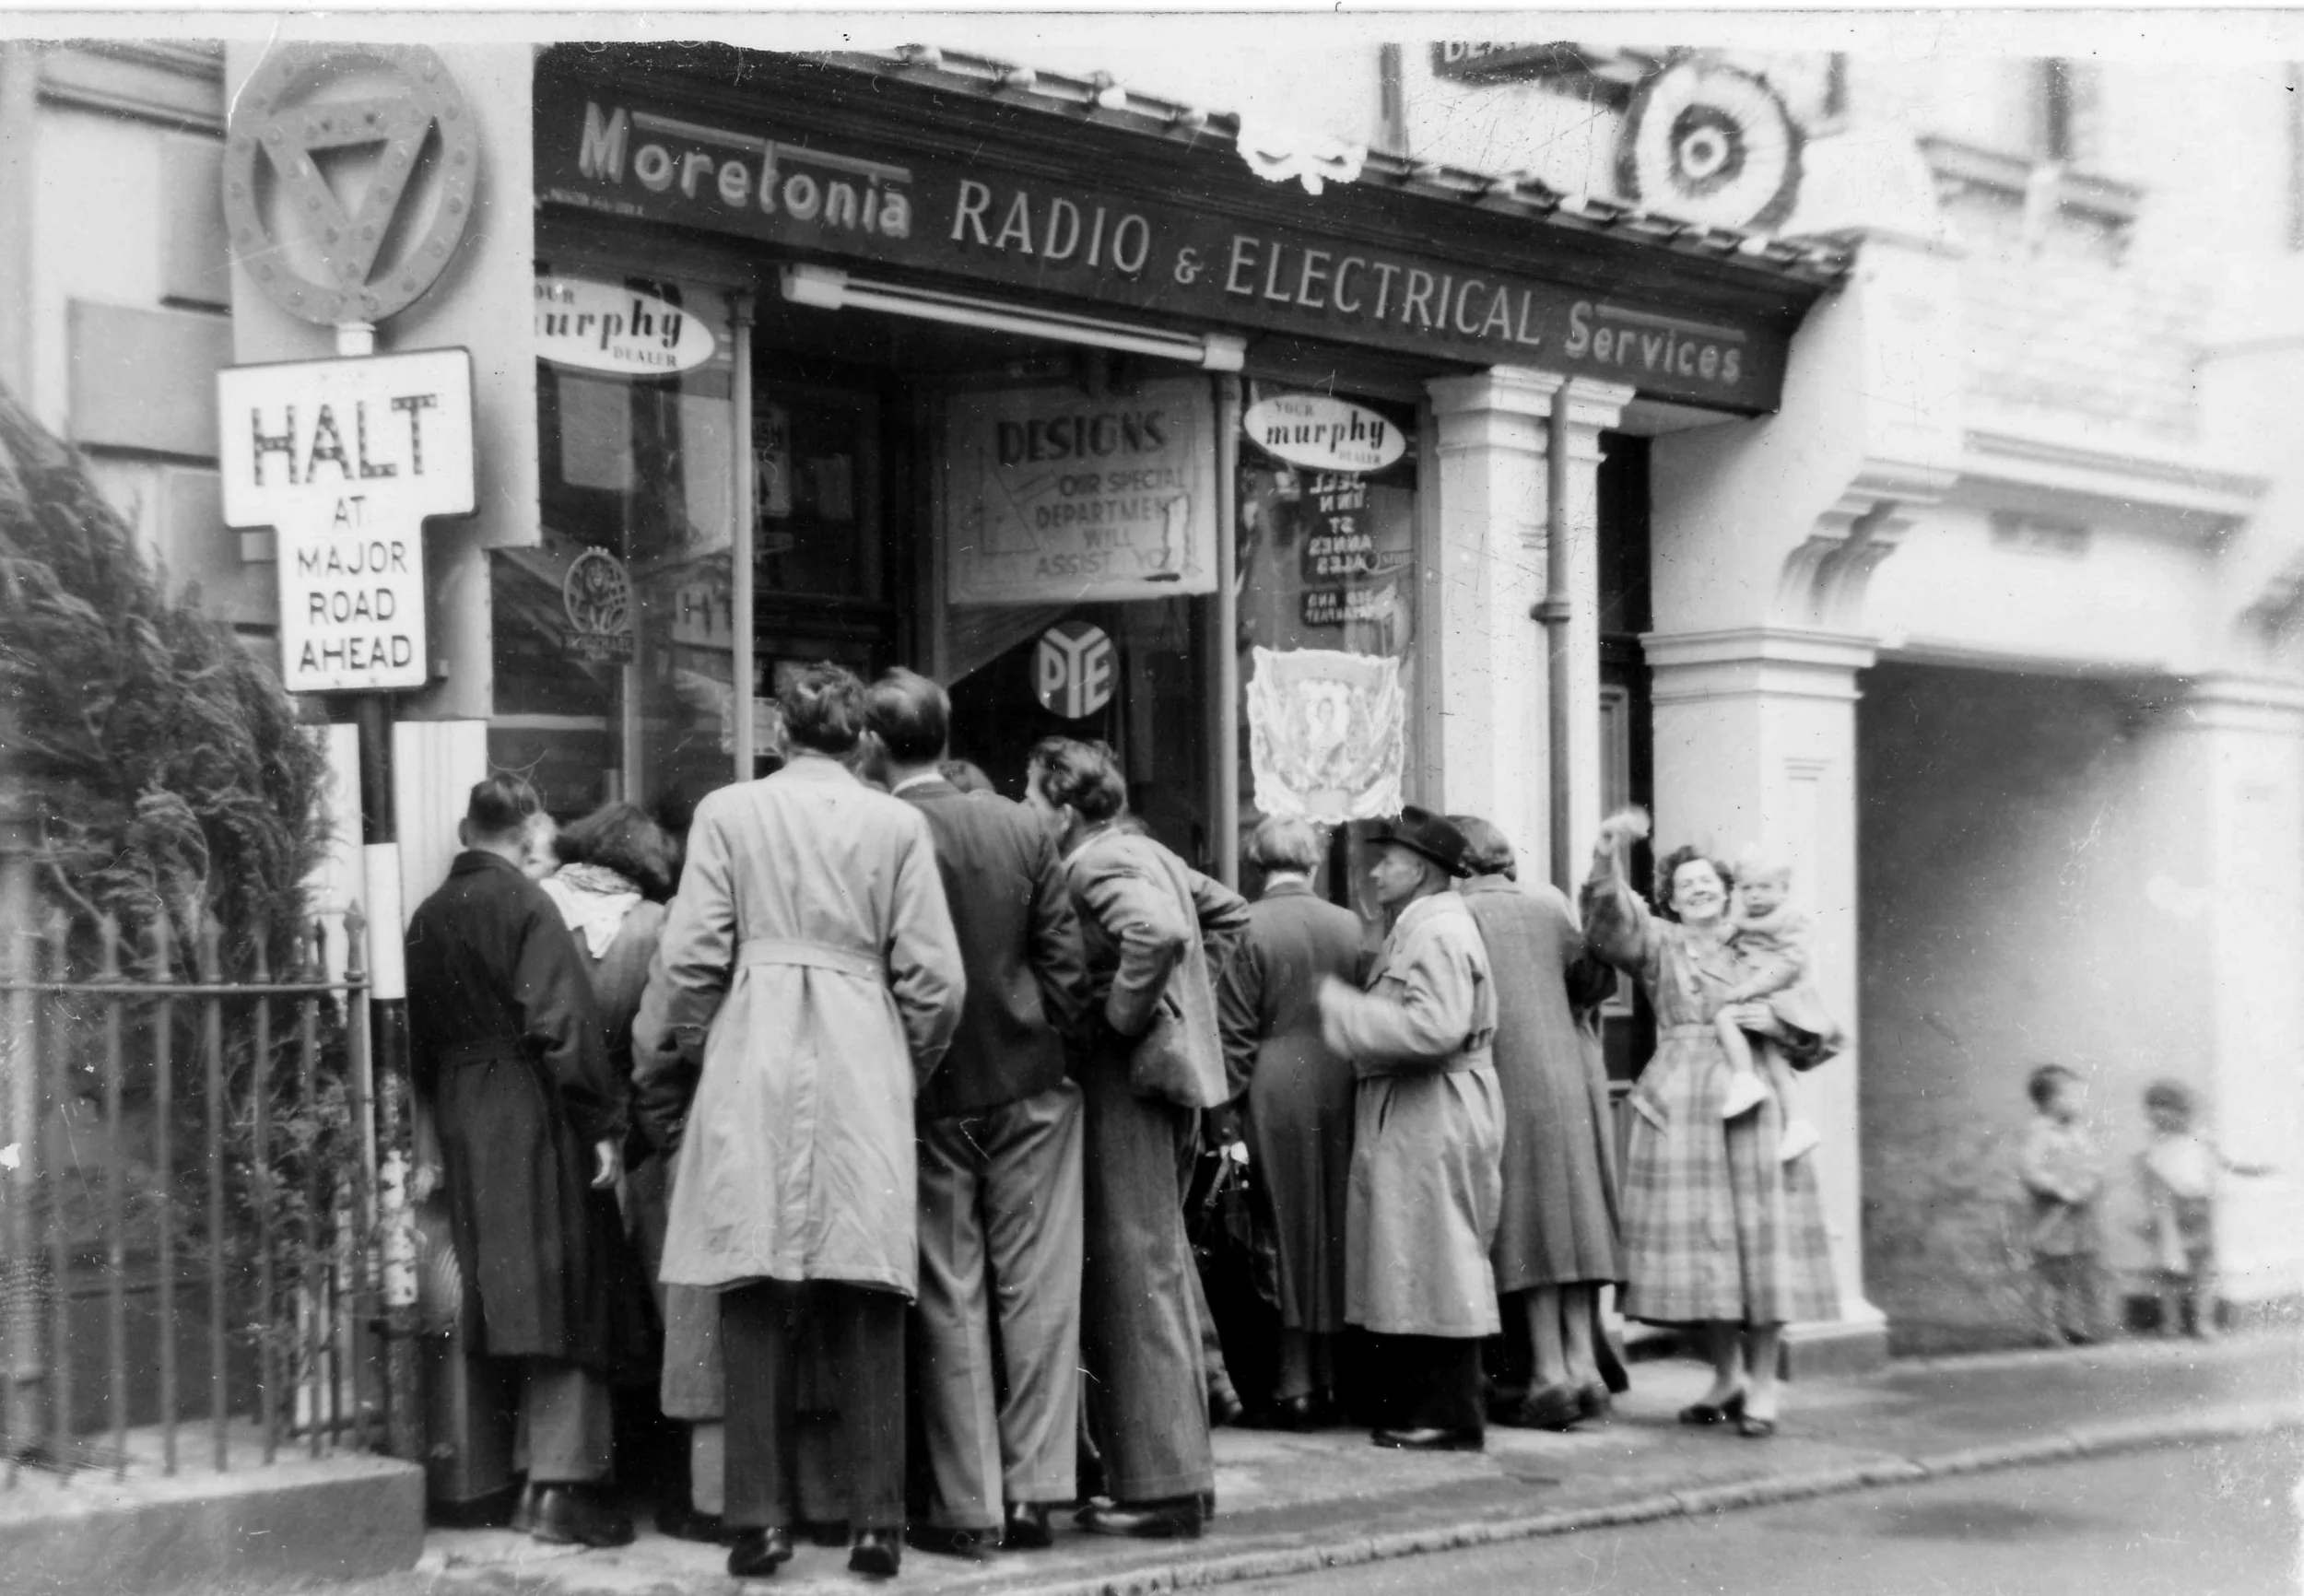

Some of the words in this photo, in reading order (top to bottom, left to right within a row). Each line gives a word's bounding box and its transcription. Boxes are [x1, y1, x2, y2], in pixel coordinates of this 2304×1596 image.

[580, 101, 911, 239] Moretonia
[950, 180, 1150, 273] RADIO
[1174, 248, 1202, 284] &
[1226, 235, 1541, 346] ELECTRICAL
[1565, 301, 1741, 384] Services
[535, 284, 574, 304] OUR
[534, 299, 682, 350] urphy
[613, 346, 676, 368] DEALER
[251, 393, 438, 487] HALT
[997, 409, 1167, 464] DESIGNS
[1266, 410, 1384, 452] murphy
[1108, 467, 1185, 493] SPECIAL
[333, 495, 367, 530] AT
[1036, 495, 1182, 530] DEPARTMEN
[1084, 527, 1134, 548] WILL
[297, 541, 408, 578] MAJOR
[1035, 551, 1113, 578] ASSIST
[309, 588, 395, 627] ROAD
[299, 634, 412, 674] AHEAD
[1039, 627, 1111, 719] PYE
